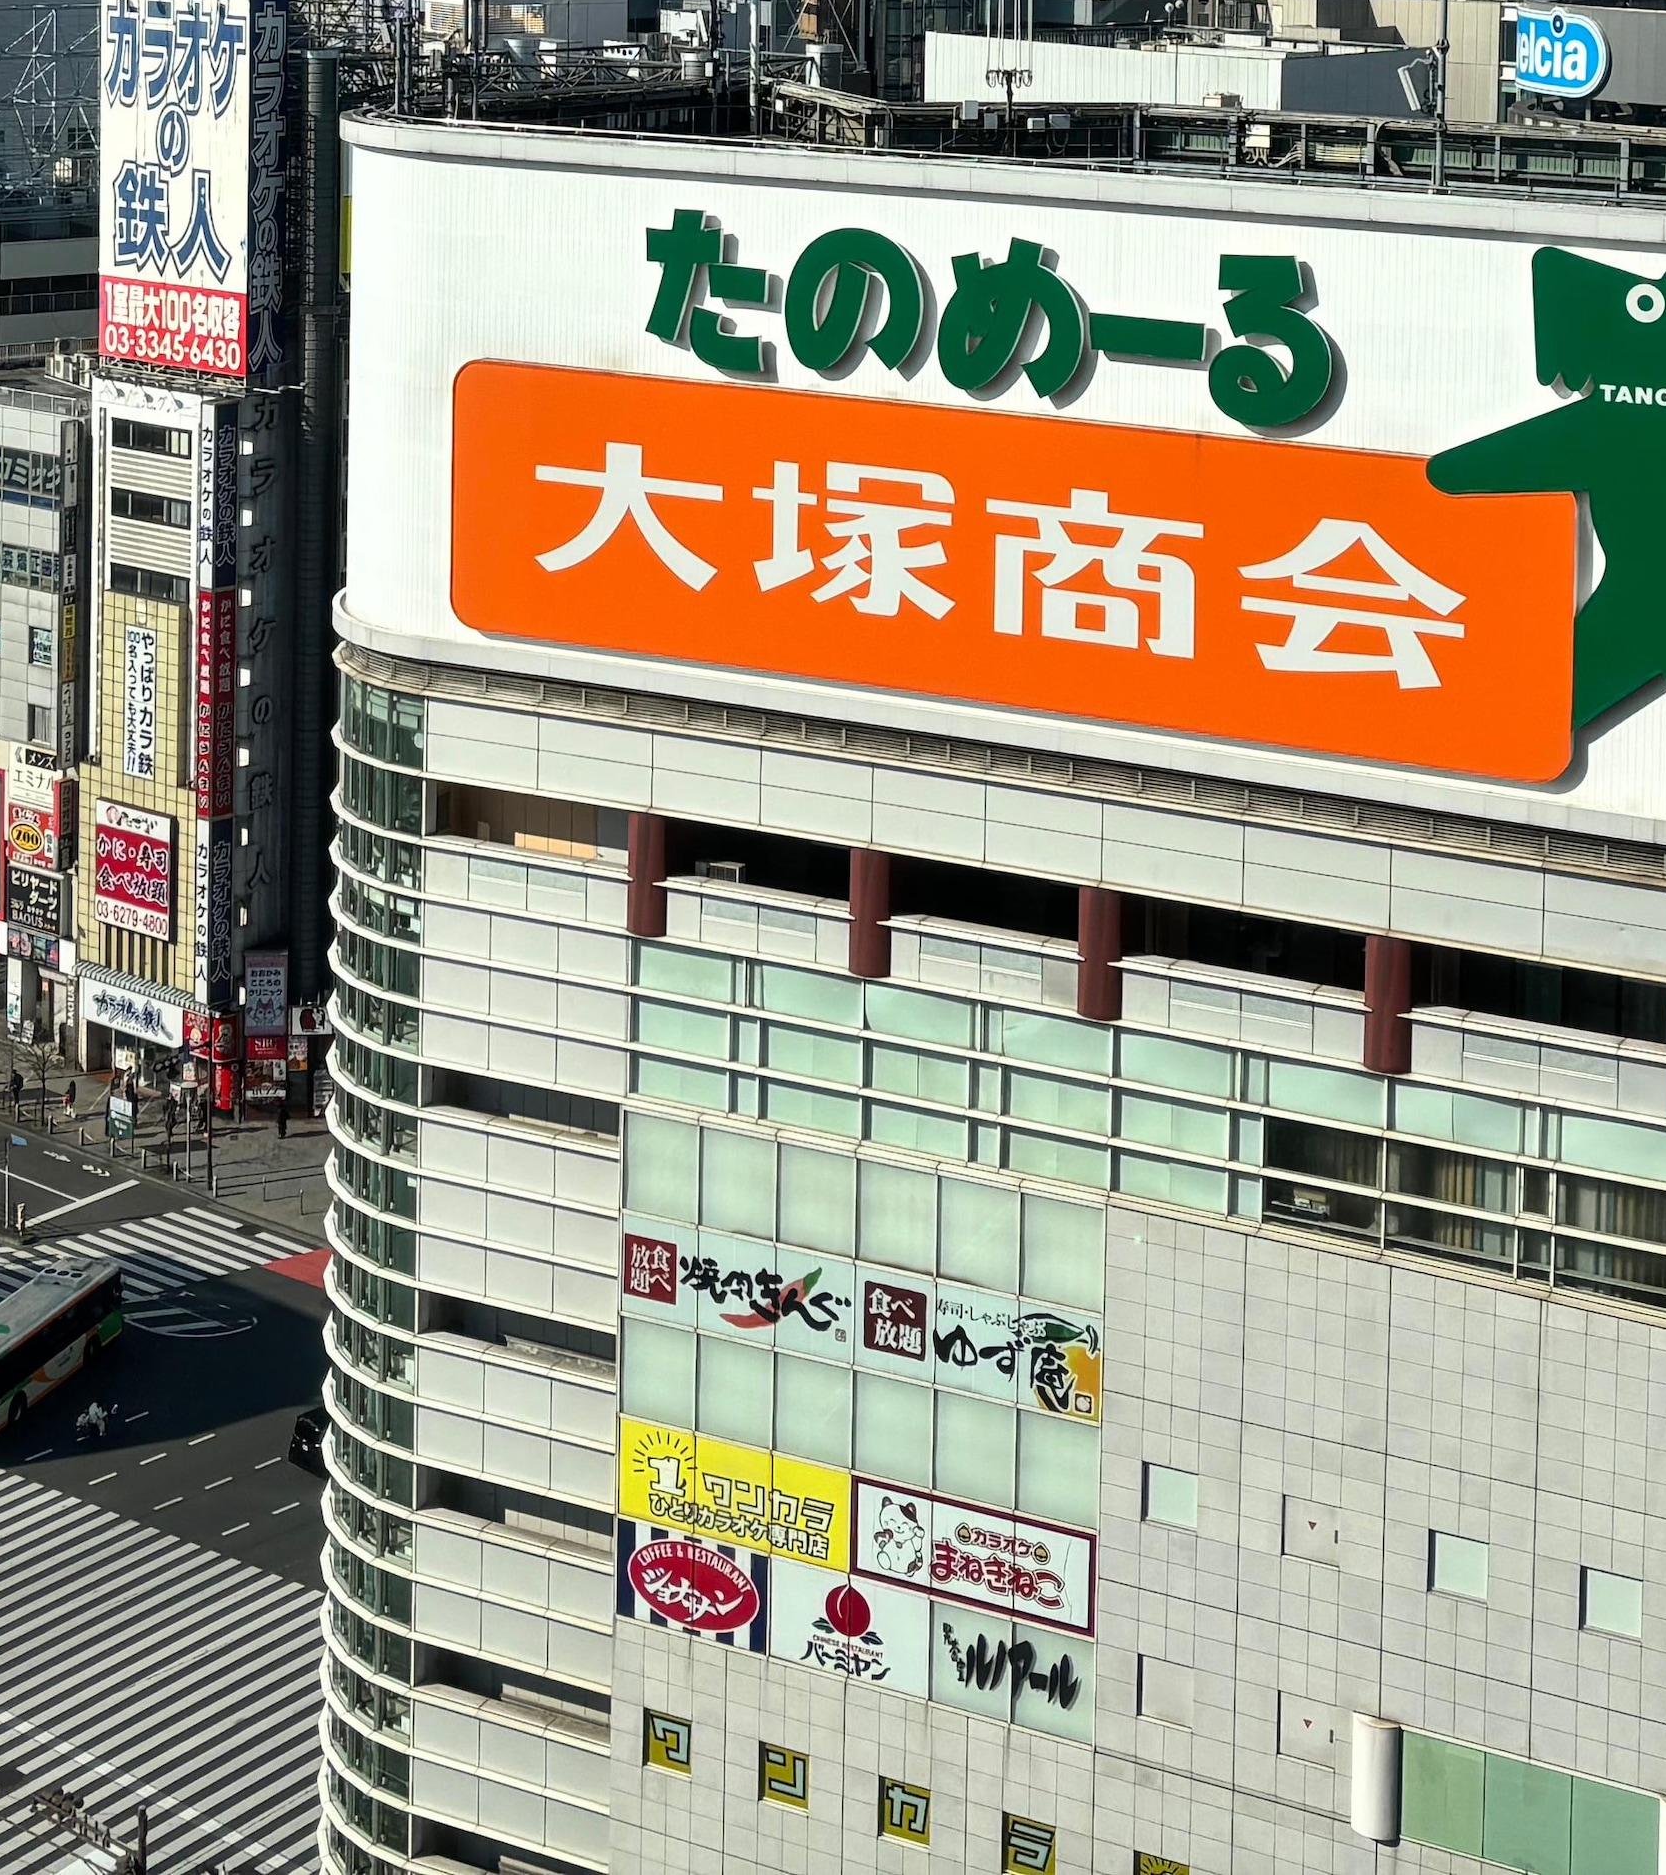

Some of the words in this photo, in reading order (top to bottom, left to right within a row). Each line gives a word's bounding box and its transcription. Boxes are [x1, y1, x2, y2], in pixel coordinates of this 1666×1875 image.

[156, 102, 189, 178] の
[249, 1, 288, 373] カラオケの鉄人
[113, 160, 232, 283] 鉄人
[105, 281, 241, 340] 1室最大100名収容
[643, 208, 1333, 429] たのめーる
[104, 325, 241, 371] 03-3345-6430
[199, 427, 213, 566] カラオケの鉄人
[217, 425, 236, 565] カラオケの鉄人
[533, 441, 1467, 690] 大塚商会
[27, 752, 55, 770] メンズ
[11, 871, 58, 894] ビリヤード
[97, 833, 167, 875] かに・寿司
[29, 891, 58, 911] ダーツ
[97, 863, 167, 906] 食べ放題
[195, 842, 209, 982] カラオケの鉄人
[211, 840, 232, 982] カラオケの鉄人
[97, 900, 167, 935] 03-6279-4800
[868, 1287, 913, 1320] 食べ
[873, 1317, 924, 1358] 放題
[933, 1324, 1077, 1412] ゆず庵
[649, 1492, 830, 1561] ひとりカラオケ専門店
[702, 1472, 835, 1530] ワンカラ
[637, 1544, 673, 1564] COFFEE
[686, 1546, 752, 1595] RESTAURANT
[971, 1525, 1034, 1559] カラオケ
[641, 1565, 744, 1622] ジョナサン
[930, 1541, 1065, 1610] まねきねこ
[800, 1640, 891, 1682] バーミヤン
[966, 1631, 1082, 1711] ルノアール
